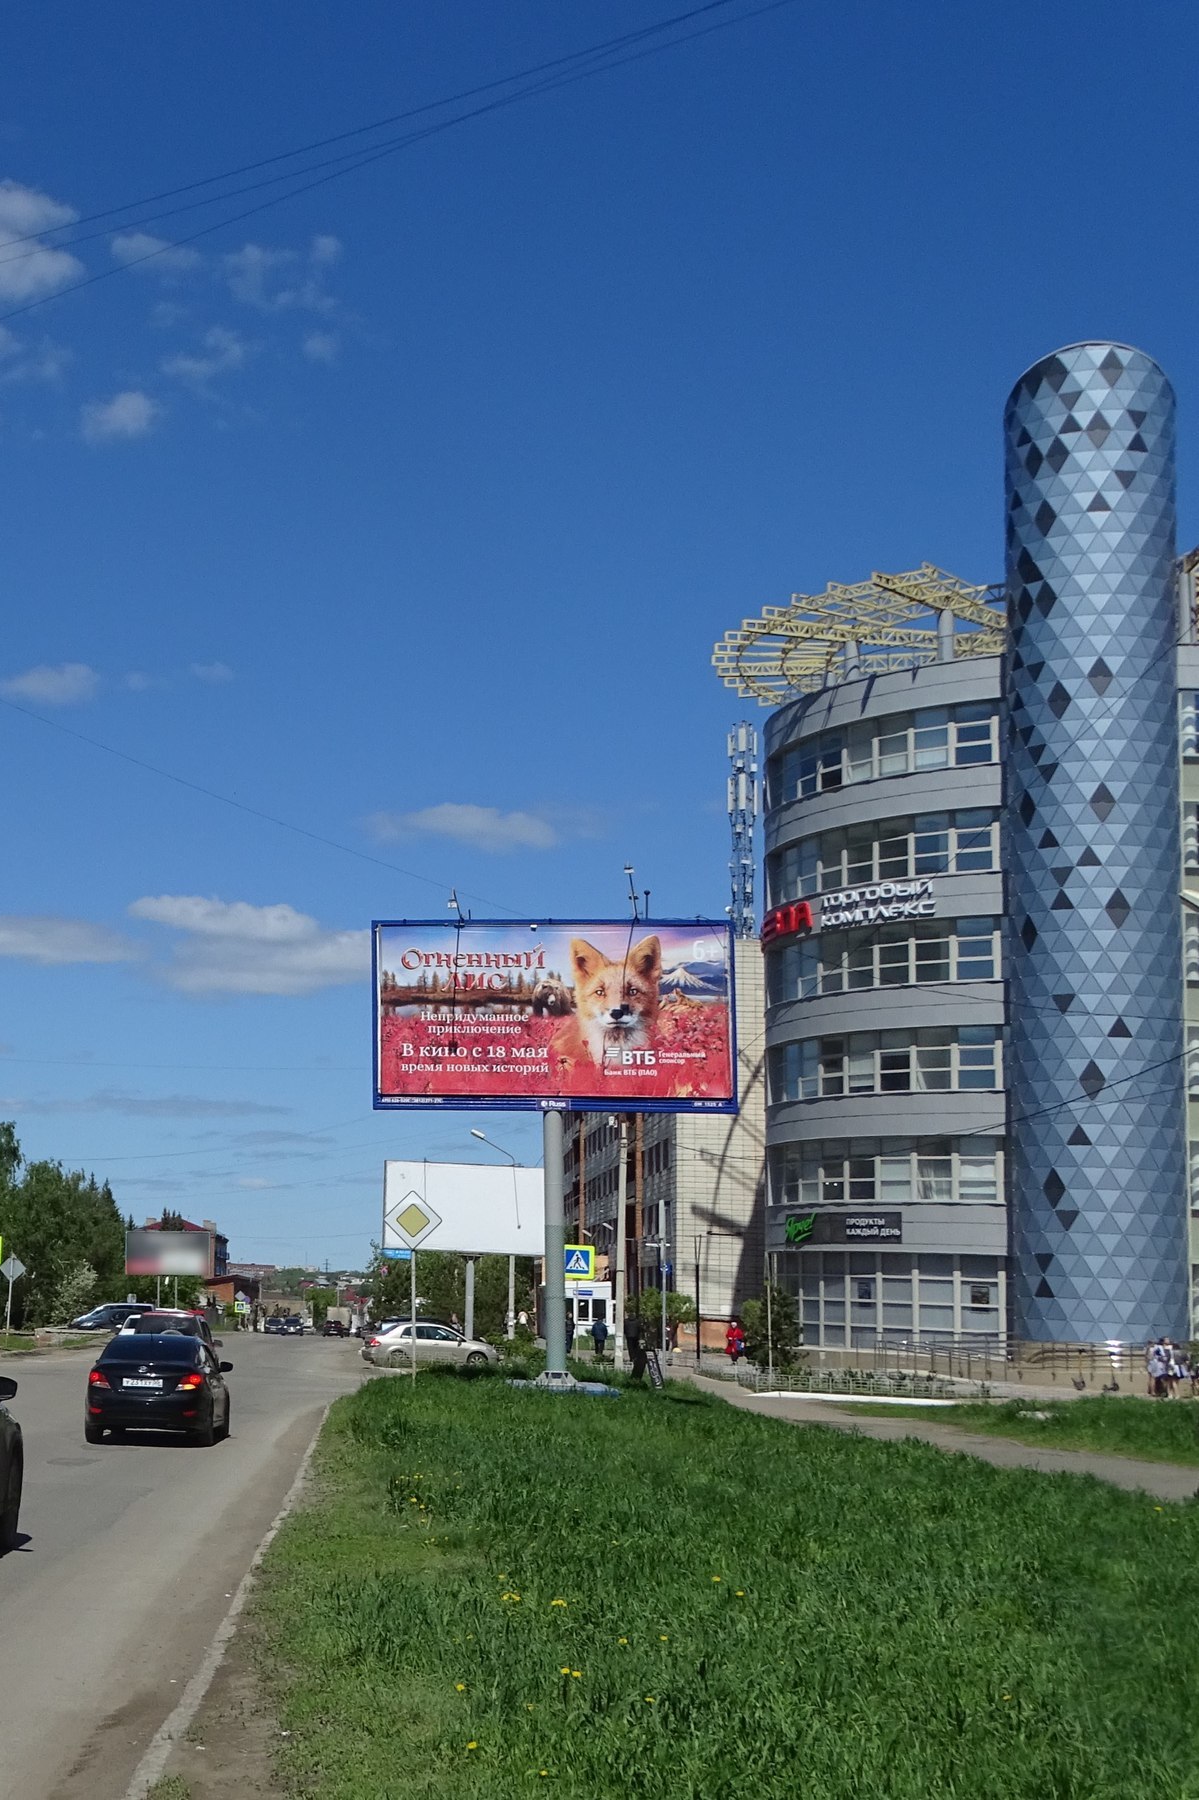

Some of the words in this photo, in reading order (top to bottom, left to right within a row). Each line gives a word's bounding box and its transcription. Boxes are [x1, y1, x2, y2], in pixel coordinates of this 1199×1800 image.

[401, 942, 546, 970] Огненный
[693, 940, 719, 960] 6+
[420, 1011, 529, 1023] Непридуманное
[427, 1025, 522, 1035] приключение
[401, 1043, 414, 1057] В
[419, 1046, 467, 1057] кино
[472, 1047, 482, 1057] с
[486, 1046, 506, 1057] 18
[511, 1047, 548, 1058] мая
[658, 1050, 706, 1058] Генеральный
[622, 1050, 656, 1065] ВТБ
[401, 1063, 443, 1073] время
[446, 1063, 489, 1073] новых
[493, 1062, 549, 1075] историй
[638, 1069, 658, 1077] (ПАО)
[845, 1218, 885, 1226] ПРОДУКТЫ
[845, 1227, 879, 1236] КАЖДЫЙ
[880, 1228, 901, 1237] ДЕНЬ
